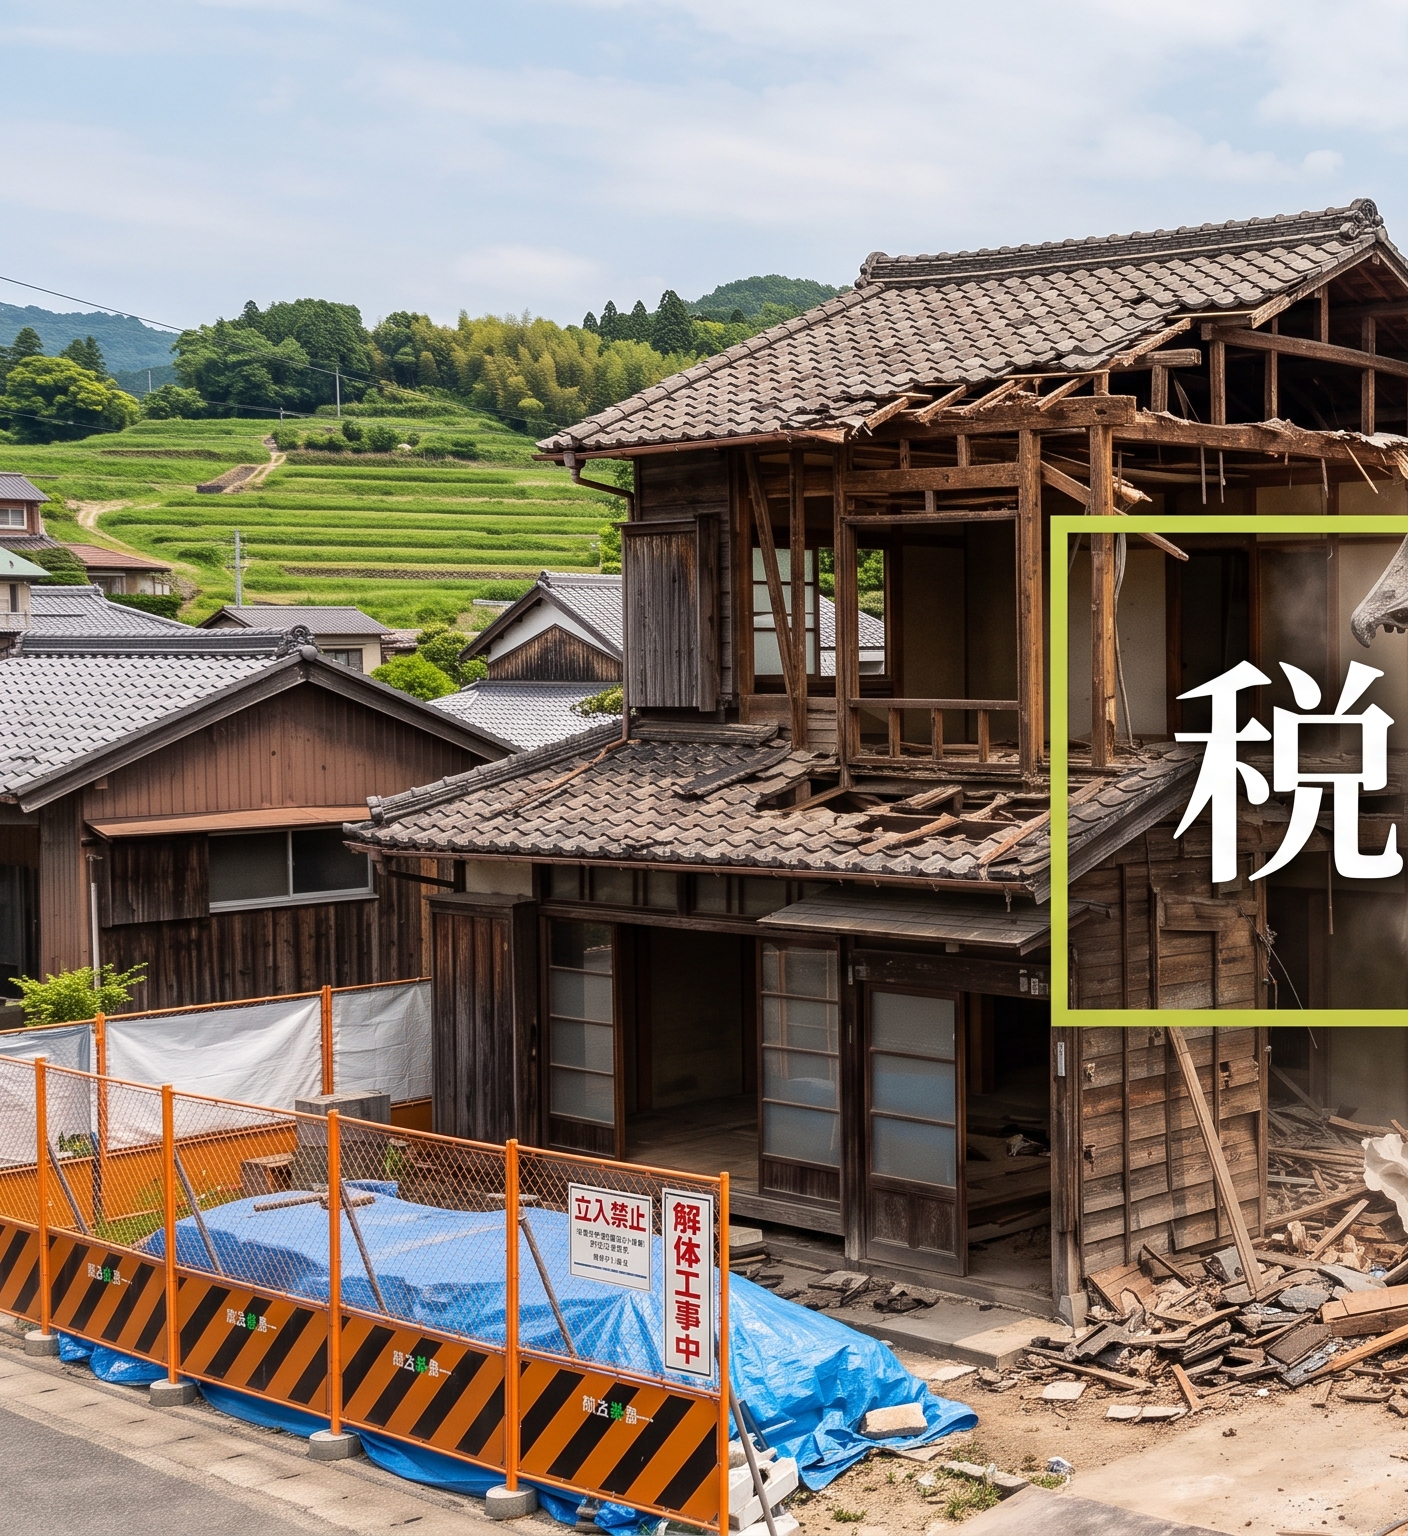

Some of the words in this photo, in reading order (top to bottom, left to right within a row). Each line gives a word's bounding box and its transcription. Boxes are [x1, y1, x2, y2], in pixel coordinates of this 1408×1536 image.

[574, 1195, 647, 1233] 立入禁止
[672, 1201, 702, 1365] 解体工事中
